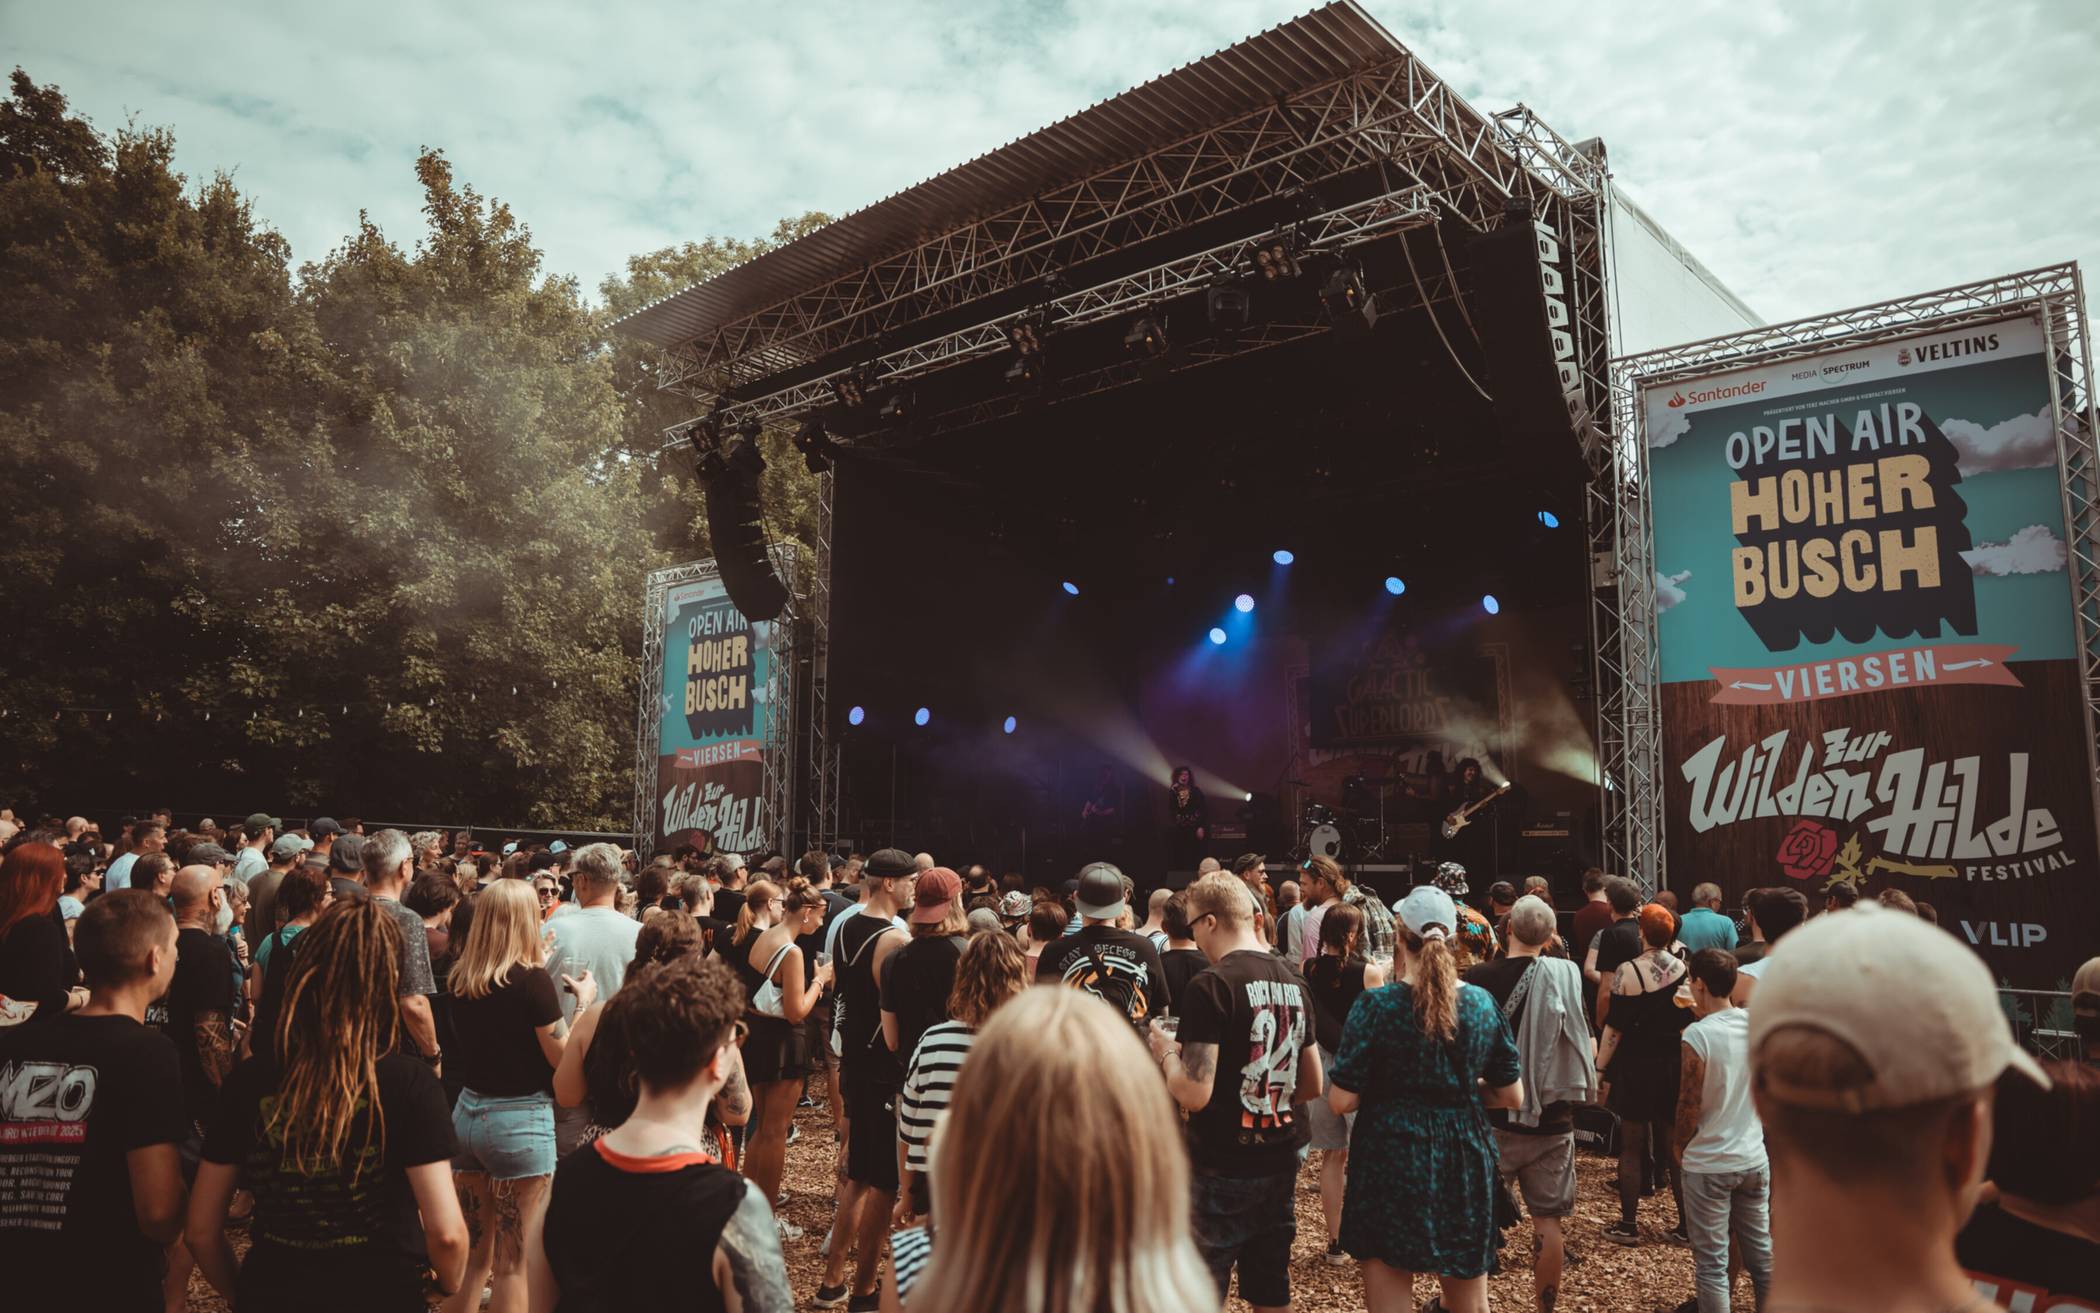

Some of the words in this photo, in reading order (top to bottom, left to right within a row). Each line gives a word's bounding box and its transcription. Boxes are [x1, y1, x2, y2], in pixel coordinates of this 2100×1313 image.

[1915, 333, 2000, 363] VELTINS
[1791, 369, 1818, 381] MEDIA
[1823, 360, 1871, 376] SPECTRUM
[1688, 379, 1767, 405] Santander
[1725, 413, 1836, 470] OPEN
[1851, 402, 1928, 452] AIR
[1729, 454, 1936, 535] HOHER
[1731, 526, 1941, 607] BUSCH
[688, 610, 723, 639] OPEN
[687, 635, 748, 675] HOHER
[1774, 649, 1936, 699] VIERSEN
[684, 674, 747, 715] BUSCH
[693, 741, 740, 767] VIERSEN
[662, 782, 718, 837] Wilden
[1681, 728, 1874, 833] Wilden
[1866, 747, 2063, 859] Hilde
[1966, 851, 2076, 881] FESTIVAL
[1960, 920, 2047, 948] VLIP
[1240, 1008, 1306, 1116] 24
